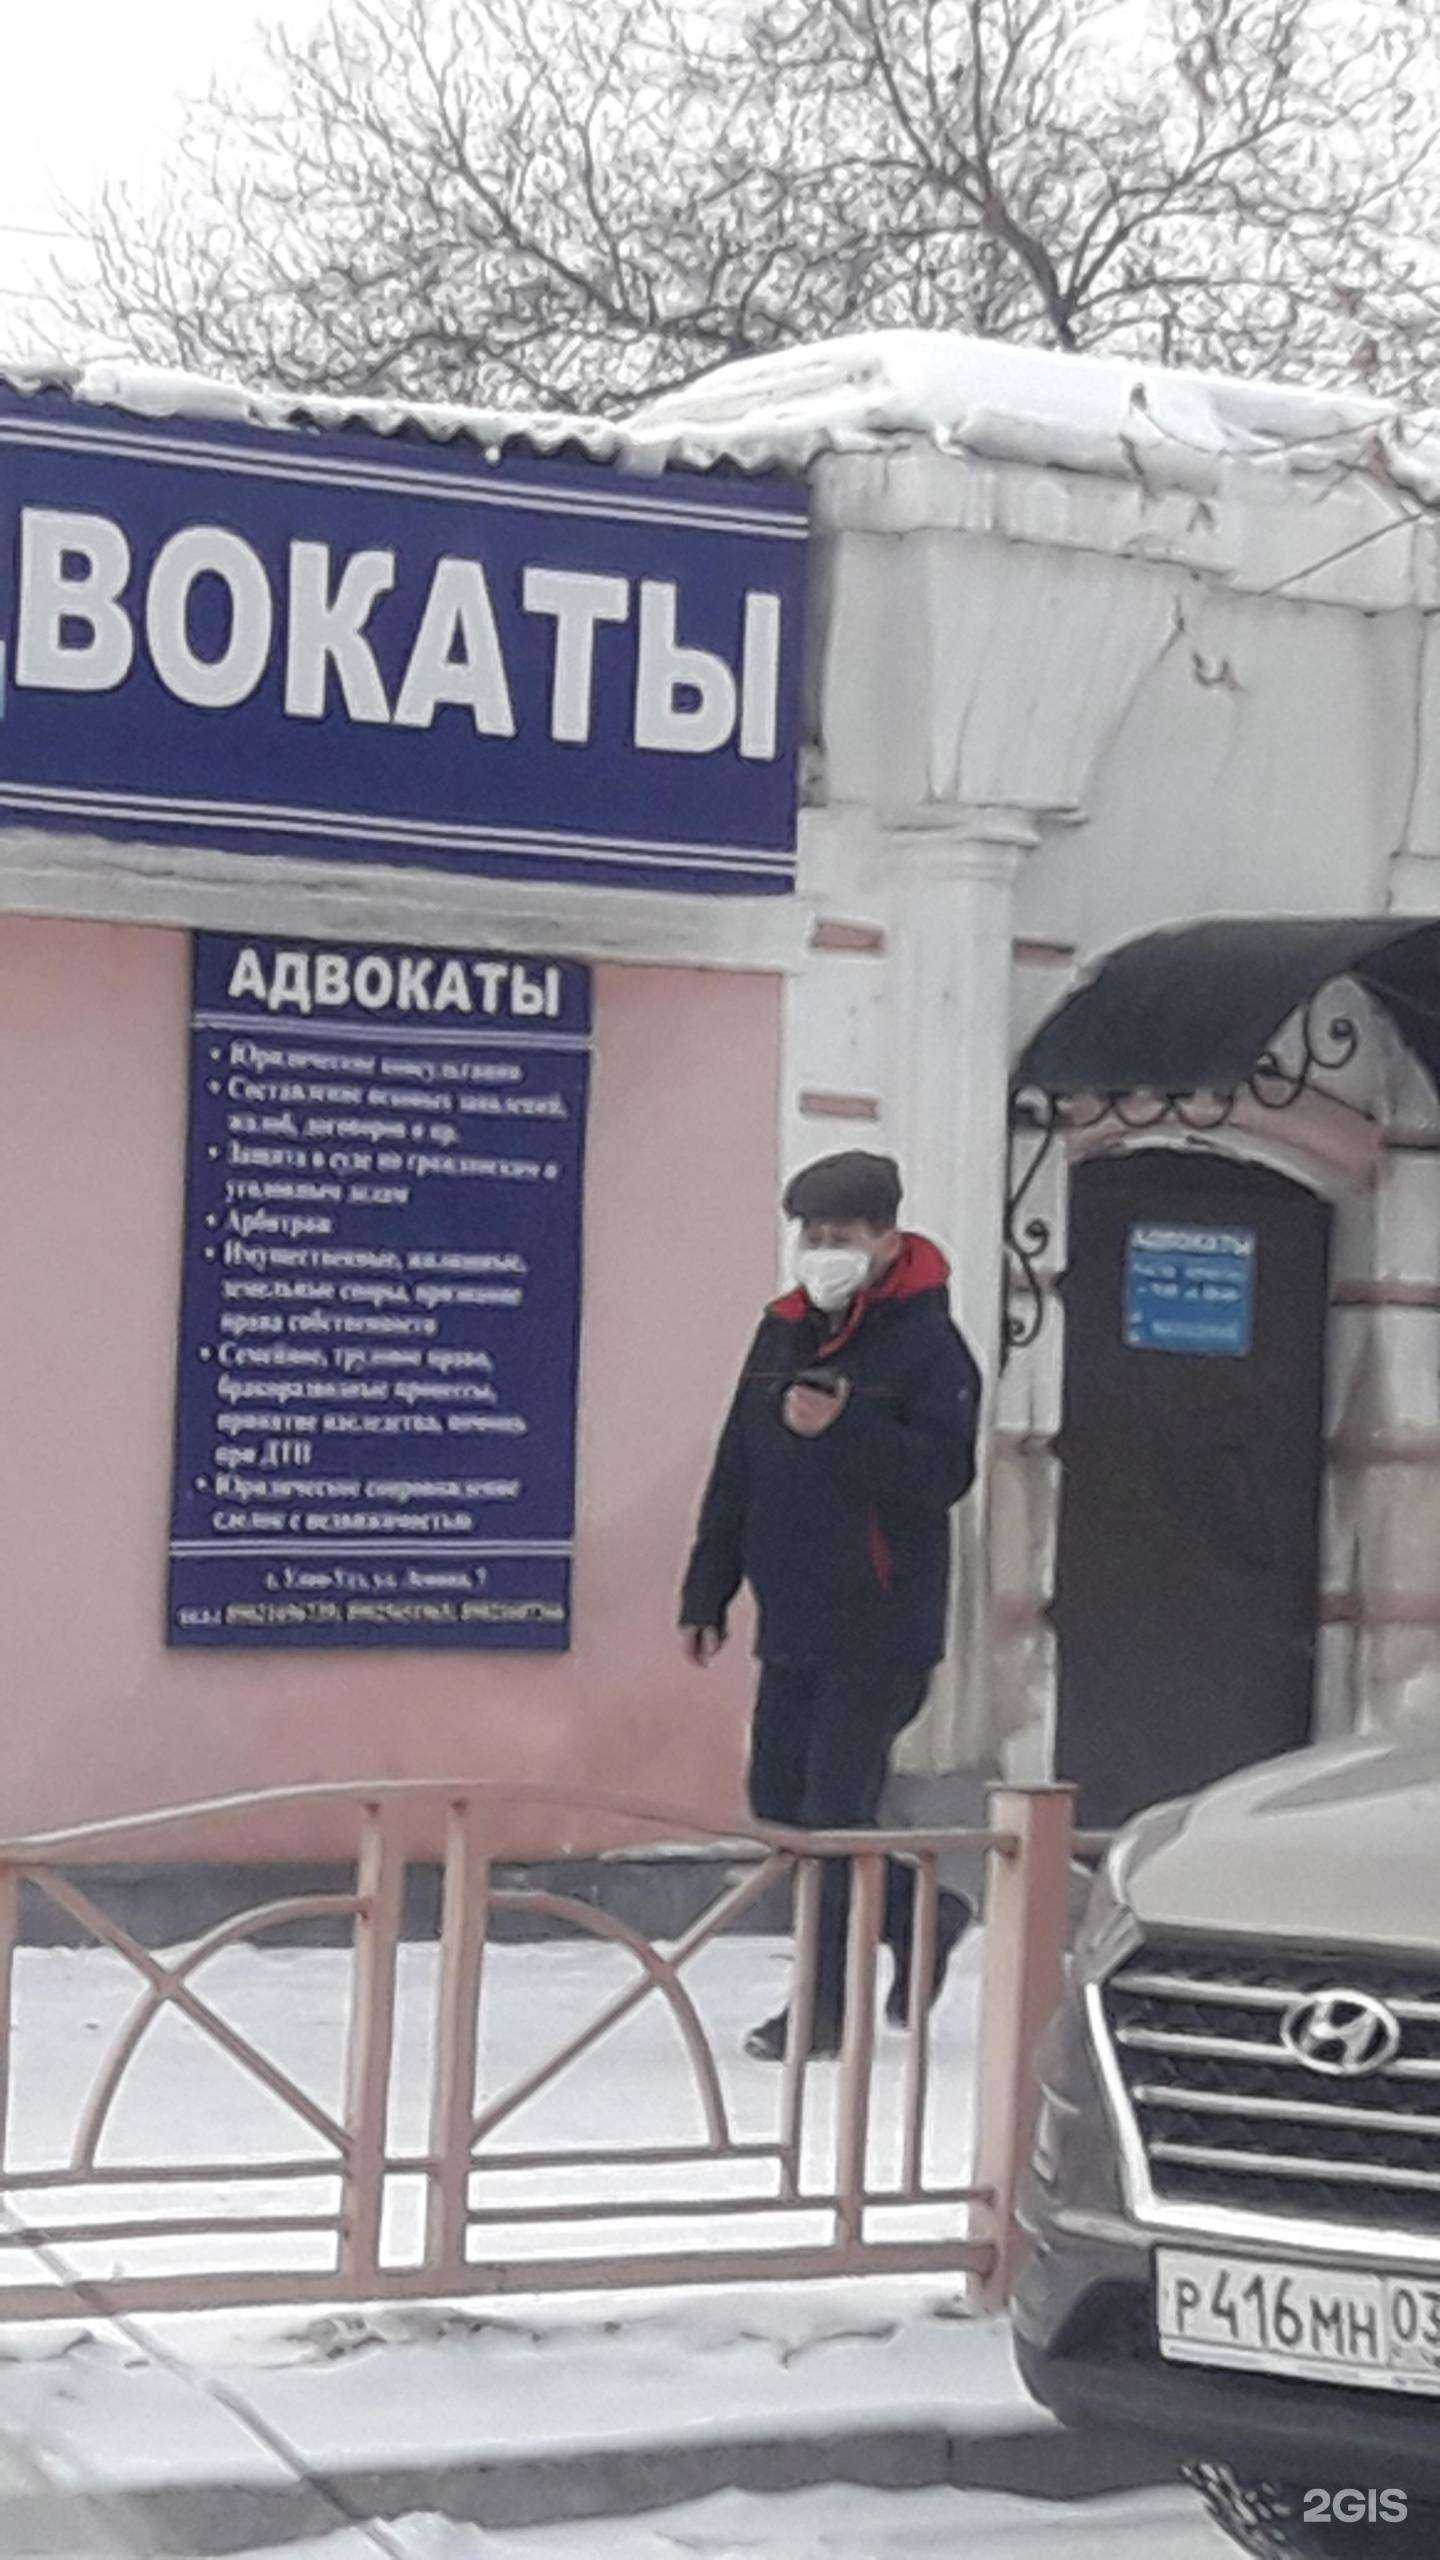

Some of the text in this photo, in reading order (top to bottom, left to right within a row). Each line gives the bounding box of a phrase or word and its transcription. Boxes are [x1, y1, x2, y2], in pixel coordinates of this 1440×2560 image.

[0, 508, 781, 761] ВОКАТЫ
[227, 948, 560, 1018] АДВОКАТЫ
[1175, 2268, 1378, 2360] Р416МН
